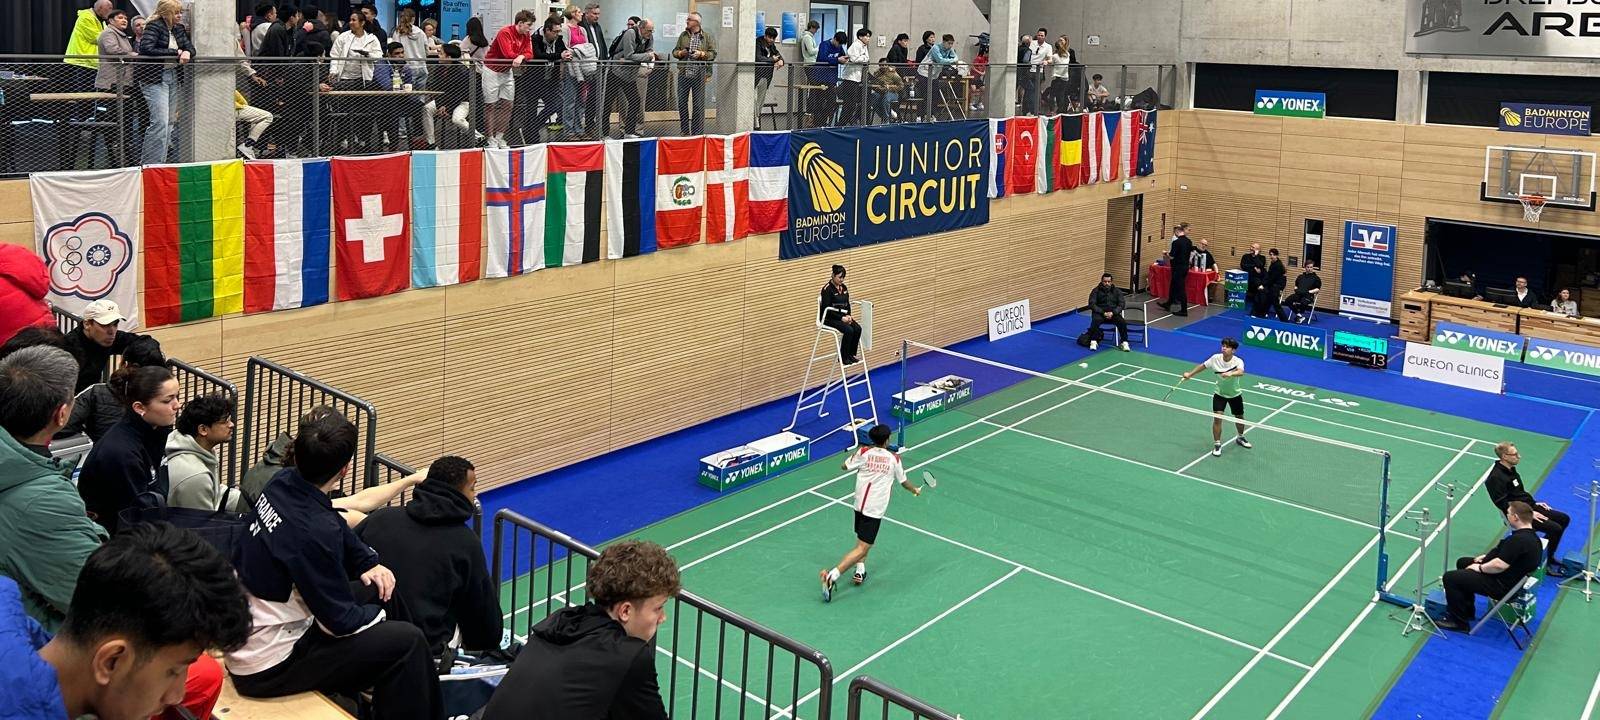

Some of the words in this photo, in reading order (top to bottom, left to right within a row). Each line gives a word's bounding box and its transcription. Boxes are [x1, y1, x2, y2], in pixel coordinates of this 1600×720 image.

[1281, 98, 1320, 111] YONEX
[1525, 108, 1590, 119] BADMINTON
[1524, 116, 1589, 131] EUROPE
[867, 138, 982, 180] JUNIOR
[866, 174, 981, 225] CIRCUIT
[796, 212, 846, 229] BADMINTON
[796, 222, 845, 245] EUROPE
[994, 304, 1025, 323] CUREON
[997, 317, 1024, 335] CLINICS
[1275, 329, 1320, 351] YONEX
[1468, 334, 1518, 355] YONEX
[1371, 353, 1386, 367] 13
[1407, 354, 1454, 373] CUREON
[1457, 364, 1500, 380] CLINICS
[1252, 382, 1317, 400] YONEX
[926, 398, 943, 411] YONEX
[784, 446, 806, 462] YONEX
[740, 461, 764, 479] YONEX
[255, 492, 283, 533] FRANCE
